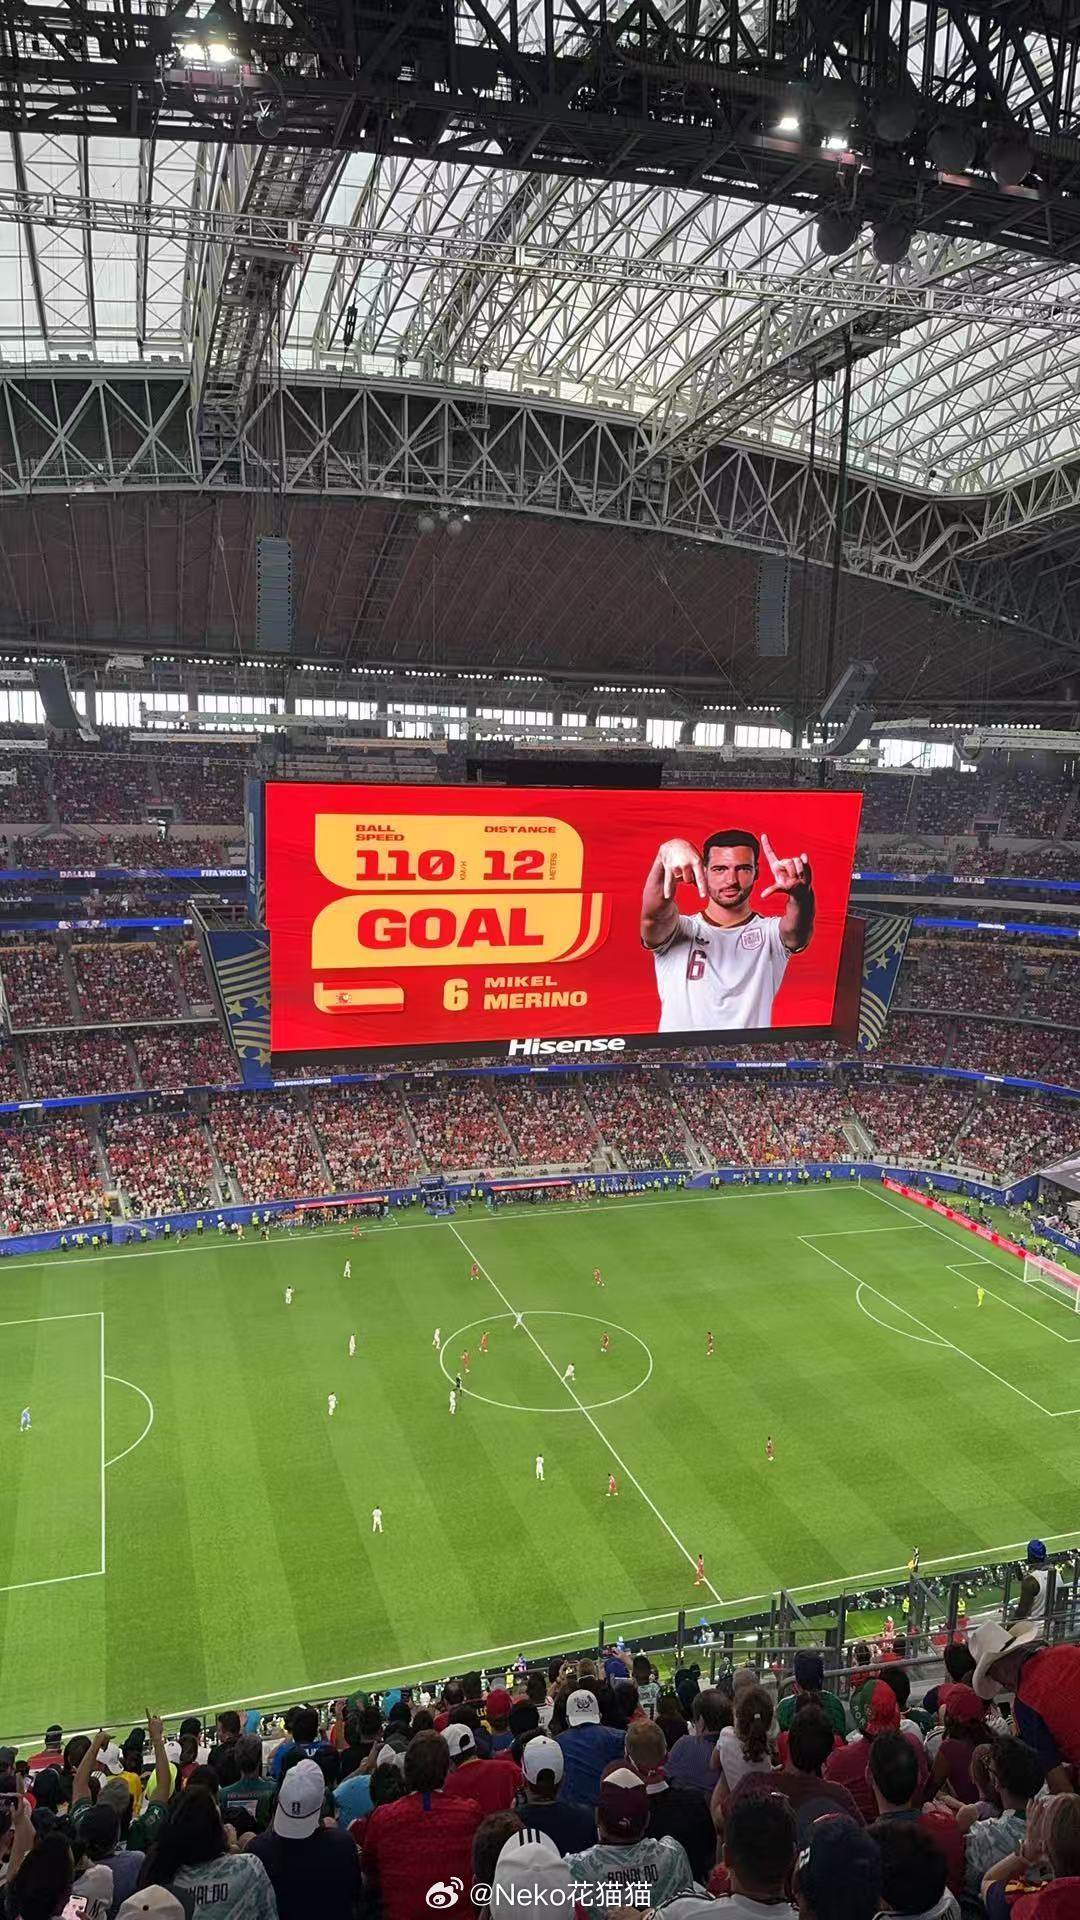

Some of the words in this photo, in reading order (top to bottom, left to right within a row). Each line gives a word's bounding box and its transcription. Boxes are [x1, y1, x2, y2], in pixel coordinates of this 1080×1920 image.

[356, 850, 455, 881] 110
[483, 850, 545, 880] 12
[549, 853, 557, 880] METERS
[953, 876, 985, 884] DALLAS
[358, 908, 544, 949] GOAL
[688, 950, 707, 980] 6
[443, 978, 468, 1011] 6
[484, 976, 558, 988] MIKEL
[484, 991, 588, 1010] MERINO
[508, 1038, 626, 1056] Hisense
